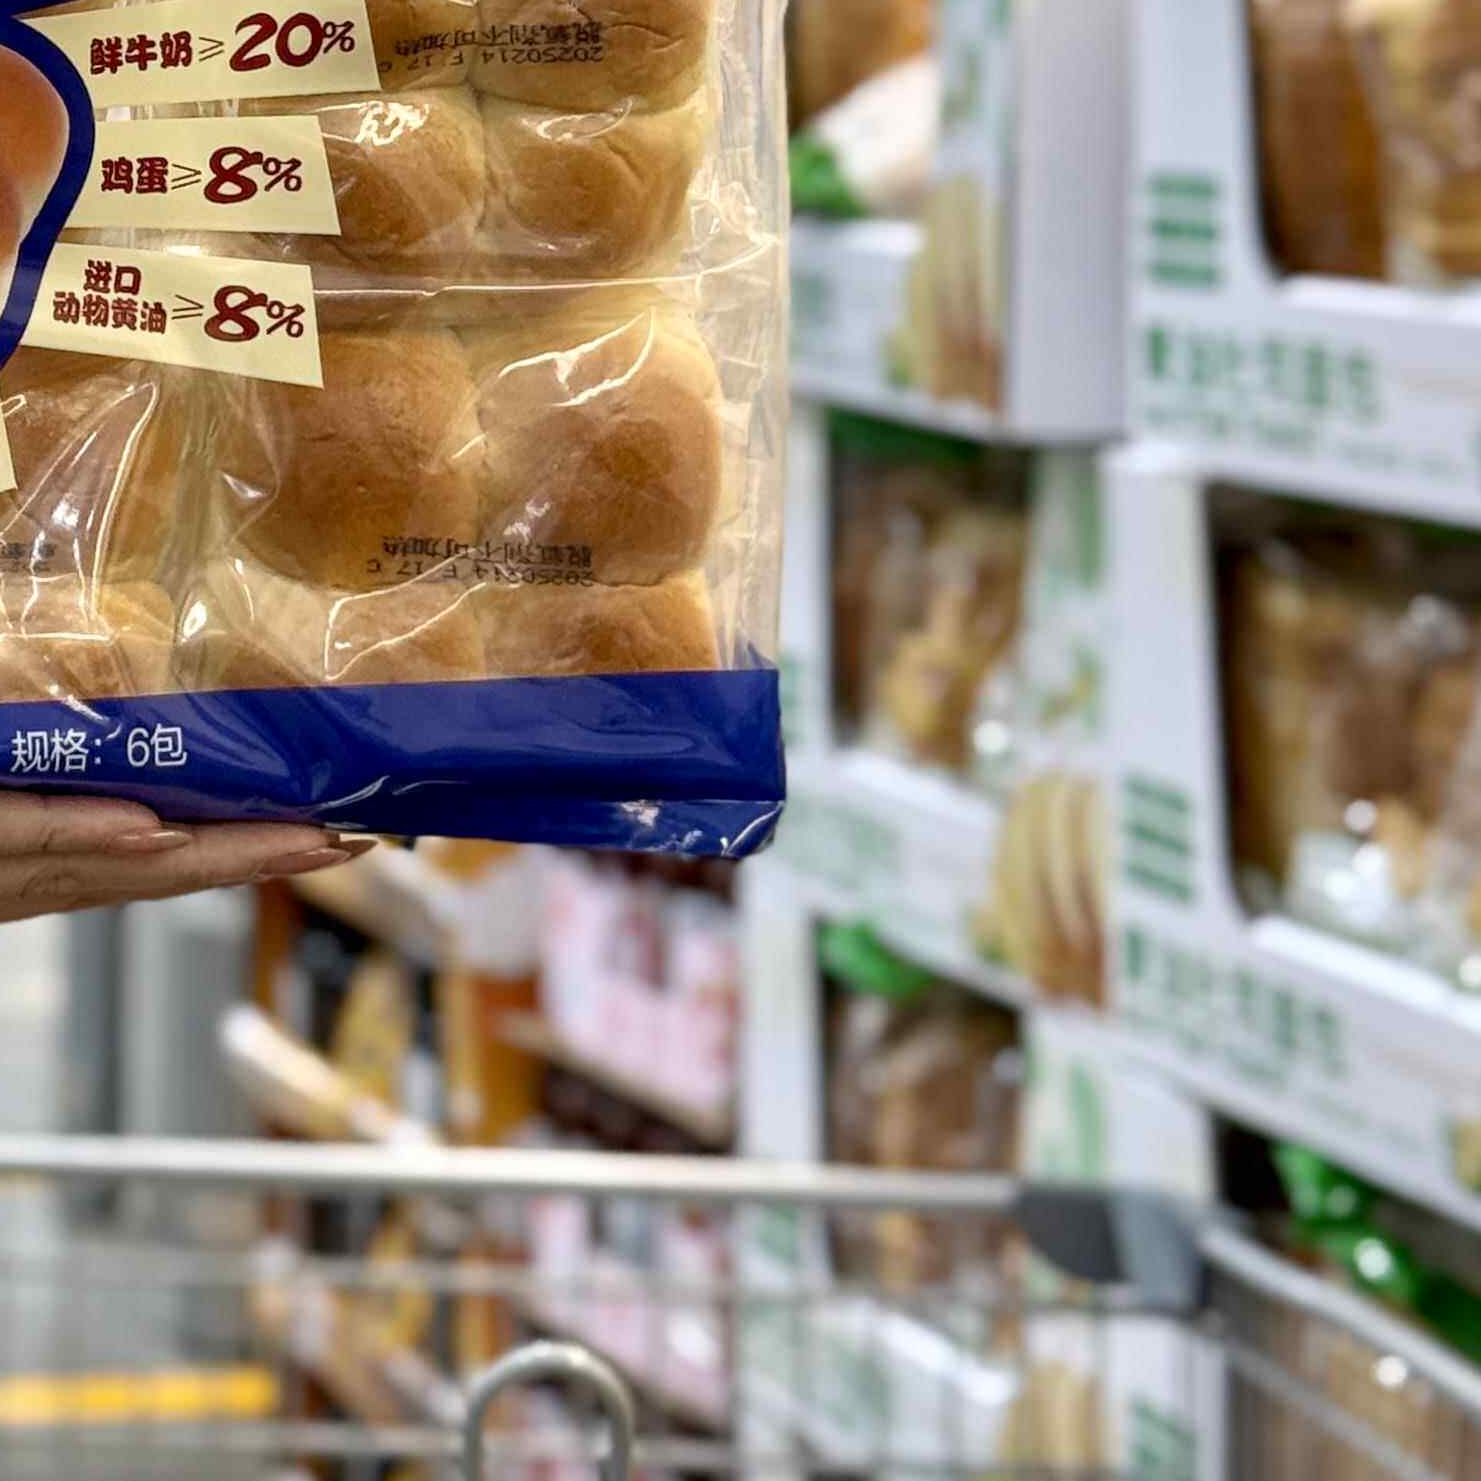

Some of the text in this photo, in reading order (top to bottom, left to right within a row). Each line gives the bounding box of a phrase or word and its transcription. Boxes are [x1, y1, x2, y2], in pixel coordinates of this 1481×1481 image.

[84, 260, 142, 294] 进口
[53, 291, 167, 334] 动物黄油
